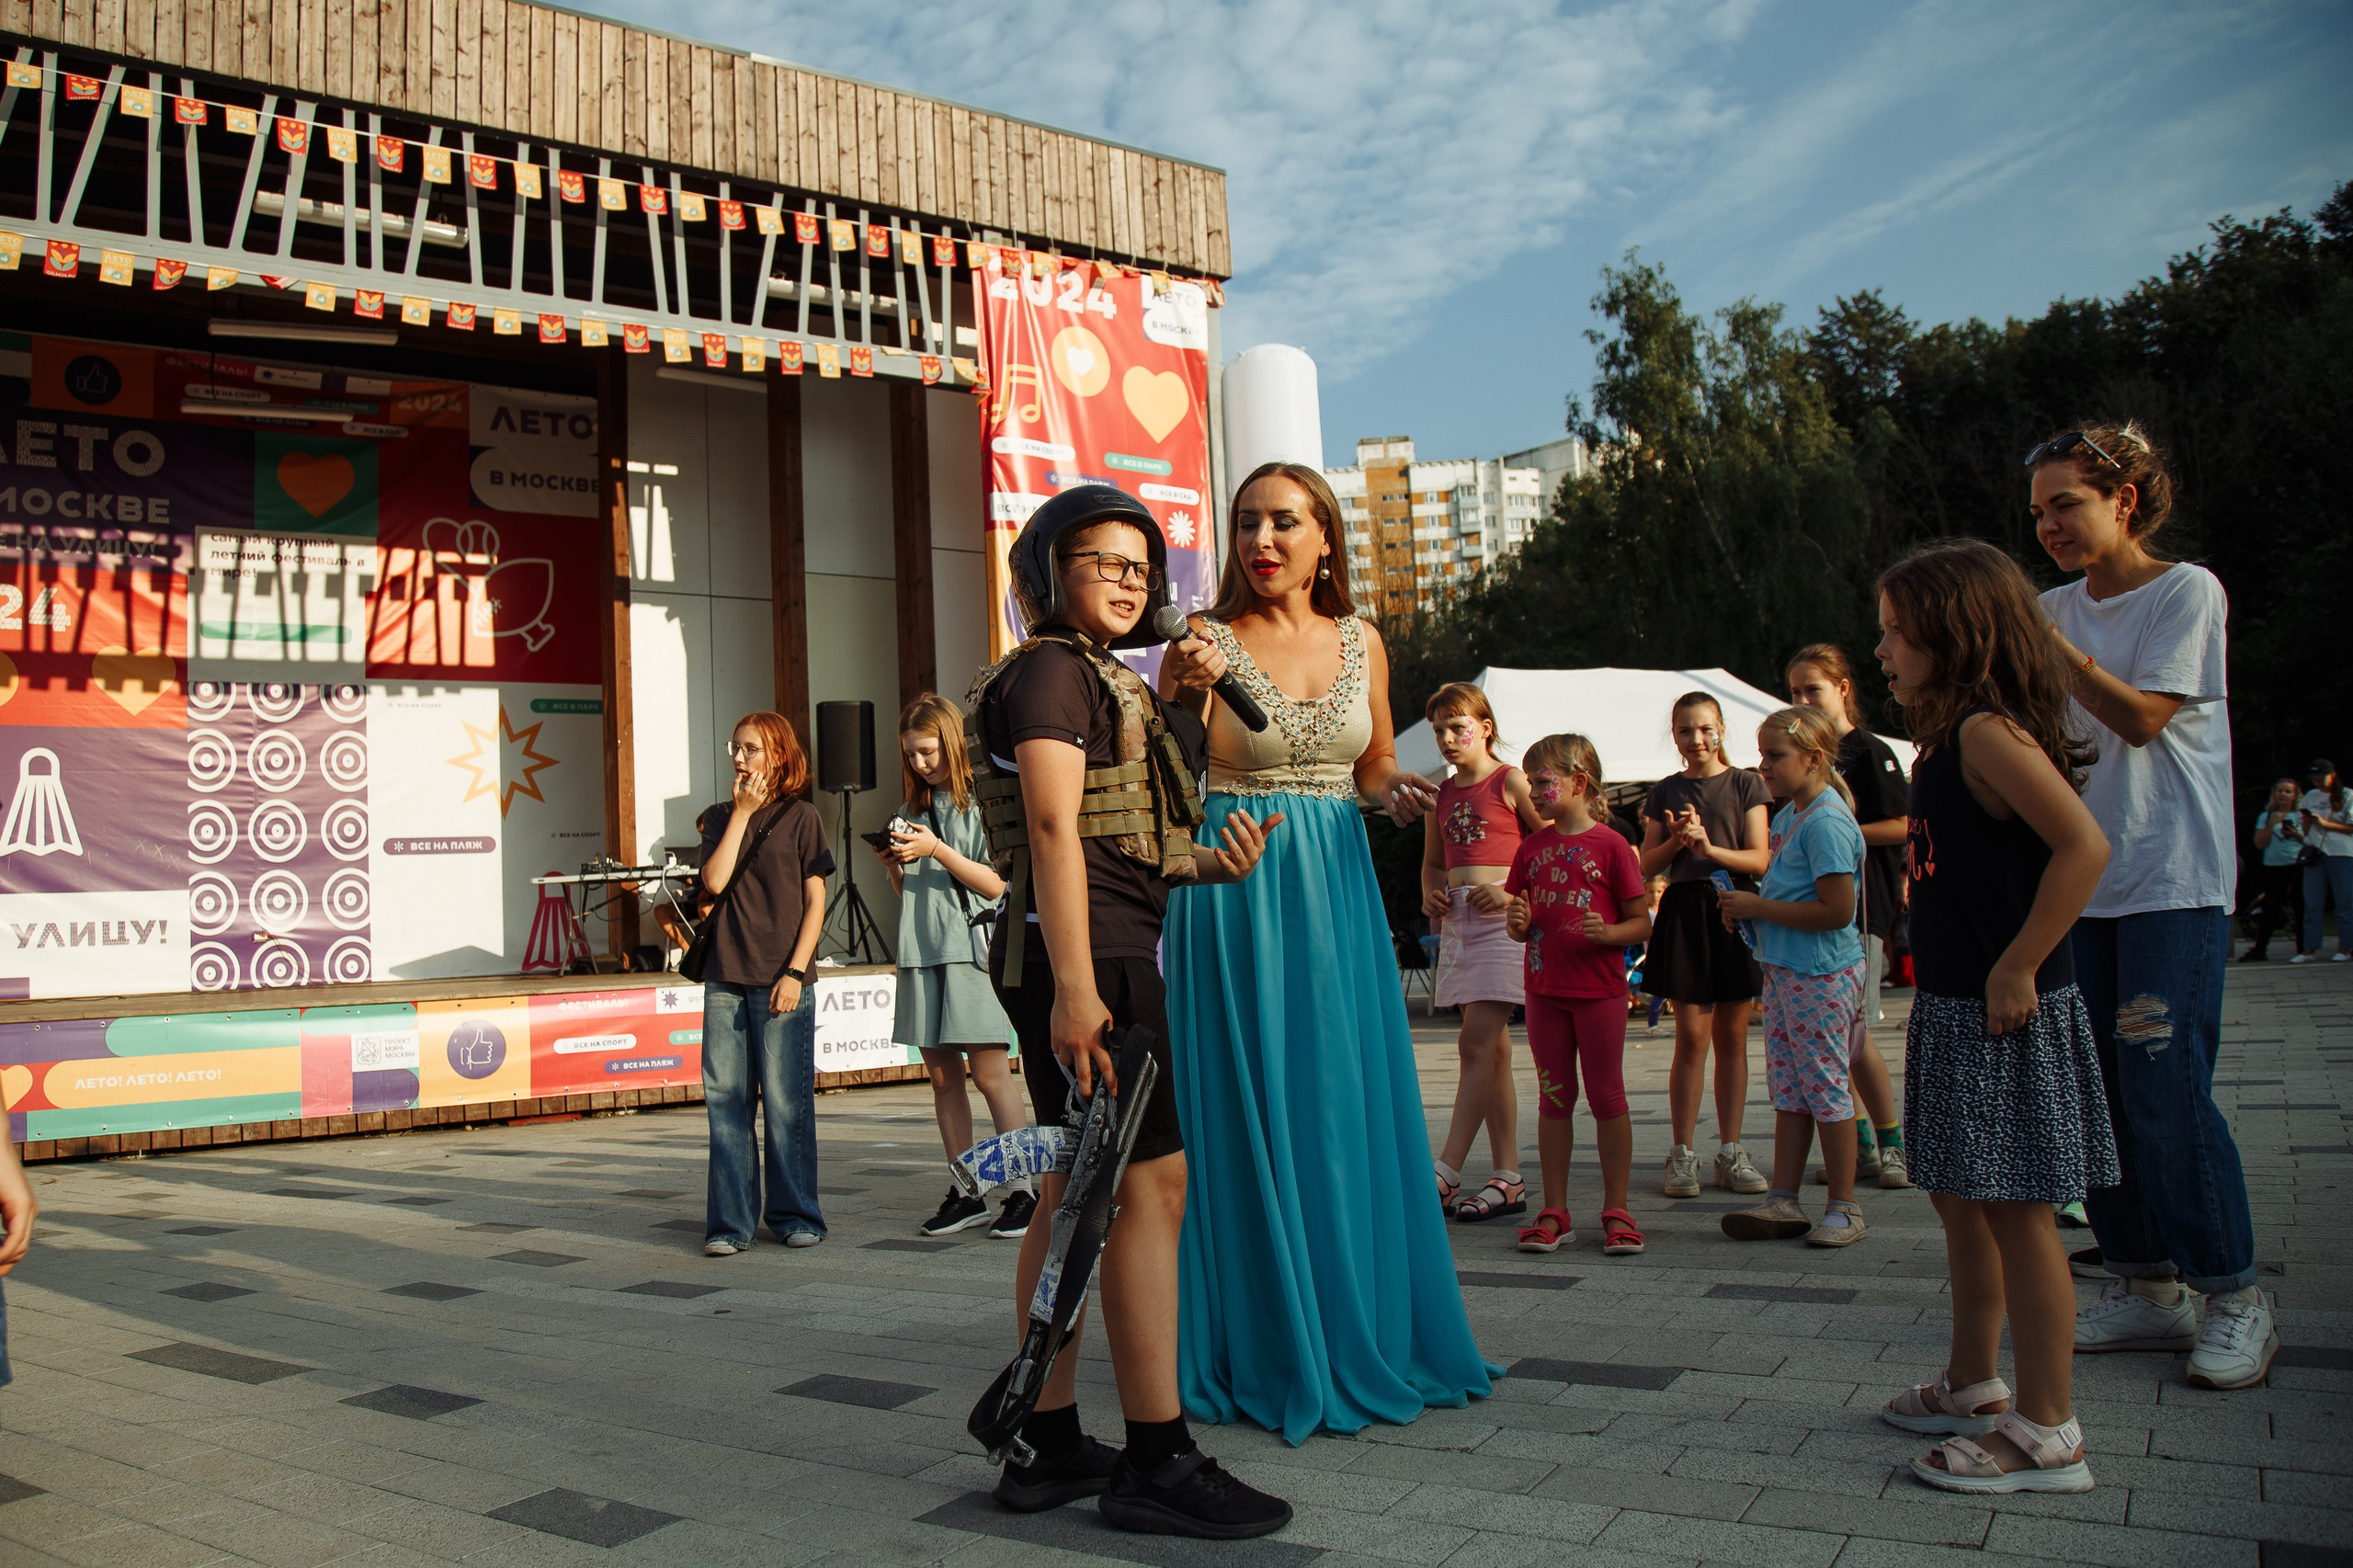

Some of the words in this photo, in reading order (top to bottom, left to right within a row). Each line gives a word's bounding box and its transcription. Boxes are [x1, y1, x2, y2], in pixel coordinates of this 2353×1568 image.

[489, 406, 594, 439] ЛЕТО
[490, 470, 505, 485] В
[60, 537, 157, 559] УЛИЦУ!
[267, 537, 335, 549] крупный
[210, 550, 266, 562] летний
[271, 551, 351, 566] фестиваль
[210, 567, 257, 579] мире!
[410, 841, 432, 851] ВСЕ
[433, 841, 449, 850] НА
[450, 840, 483, 850] ПЛЯЖ
[1551, 867, 1568, 884] DO
[9, 919, 167, 949] УЛИЦУ!
[823, 989, 891, 1012] ЛЕТО
[823, 1042, 832, 1053] В
[650, 1060, 674, 1068] ПЛЯЖ
[74, 1075, 122, 1090] ЛЕТО!
[126, 1072, 172, 1086] ЛЕТО!
[176, 1069, 222, 1083] ЛЕТО!
